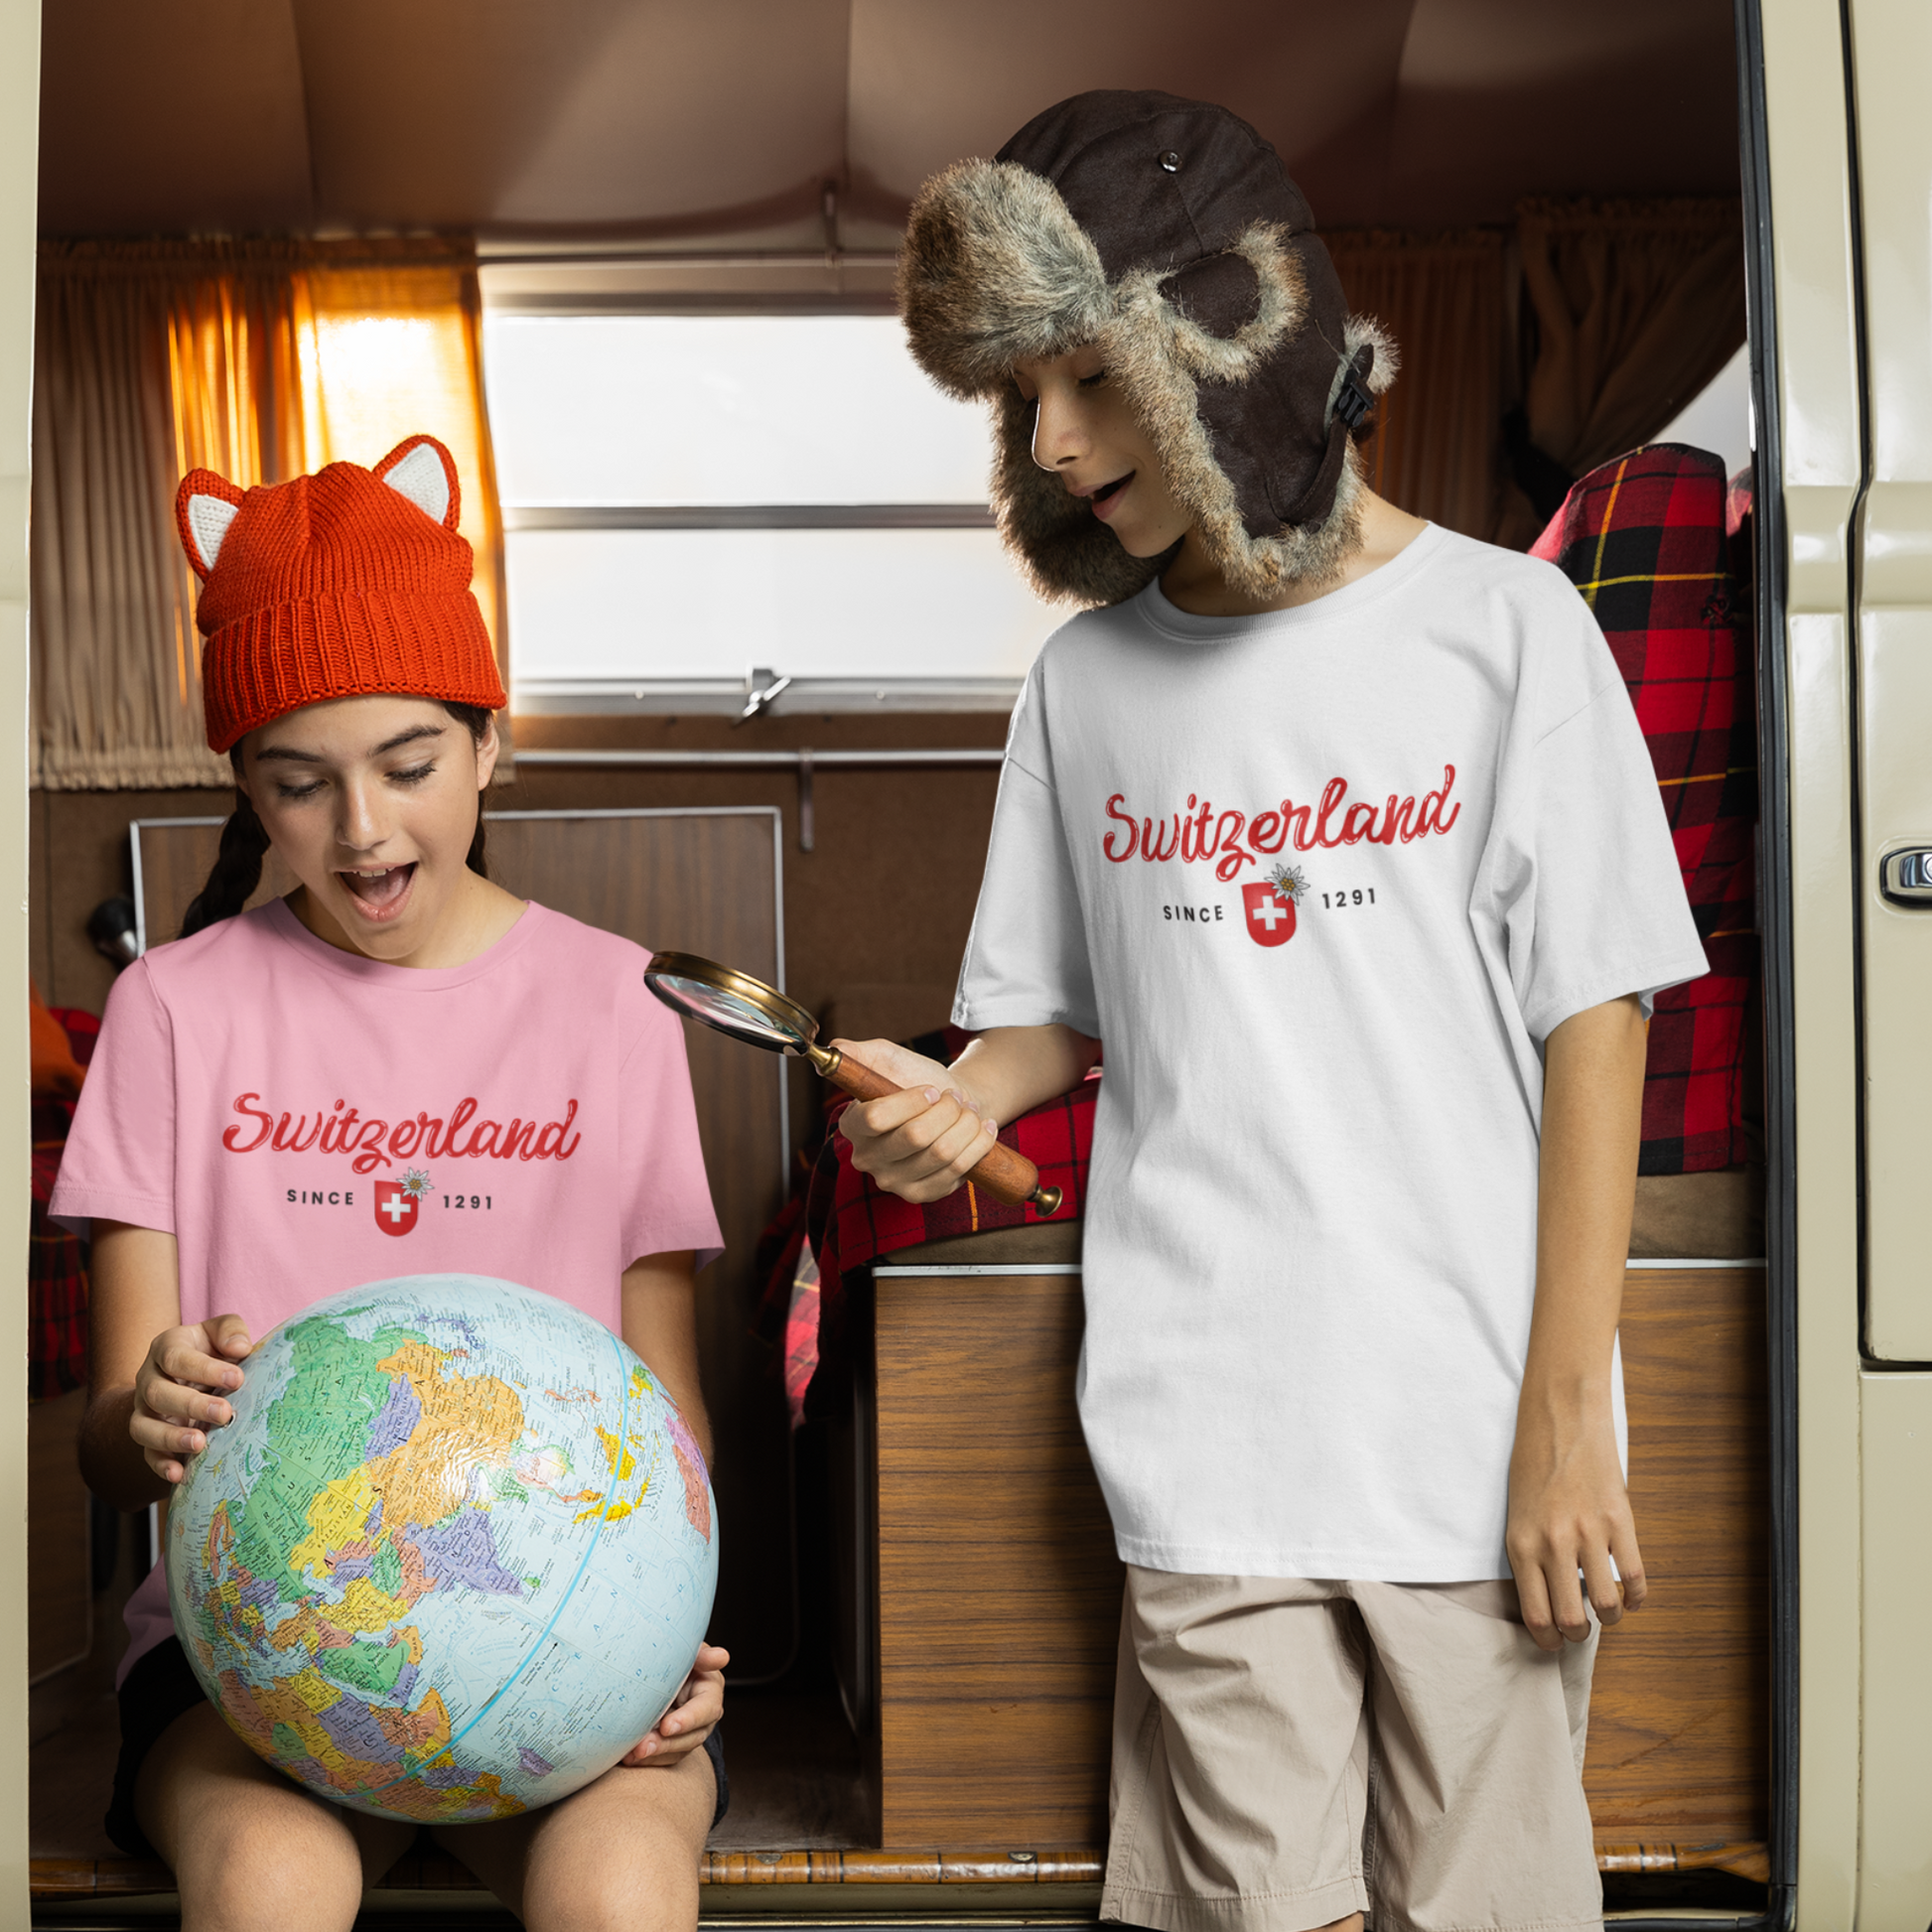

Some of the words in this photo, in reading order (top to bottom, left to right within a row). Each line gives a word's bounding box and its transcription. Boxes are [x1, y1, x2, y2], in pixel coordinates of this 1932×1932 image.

[1103, 763, 1461, 883] Switzerland
[1163, 904, 1224, 923] SINCE
[1321, 888, 1376, 909] 1291
[221, 1092, 582, 1174] Switzerland
[286, 1188, 354, 1205] SINCE
[443, 1194, 492, 1210] 1291
